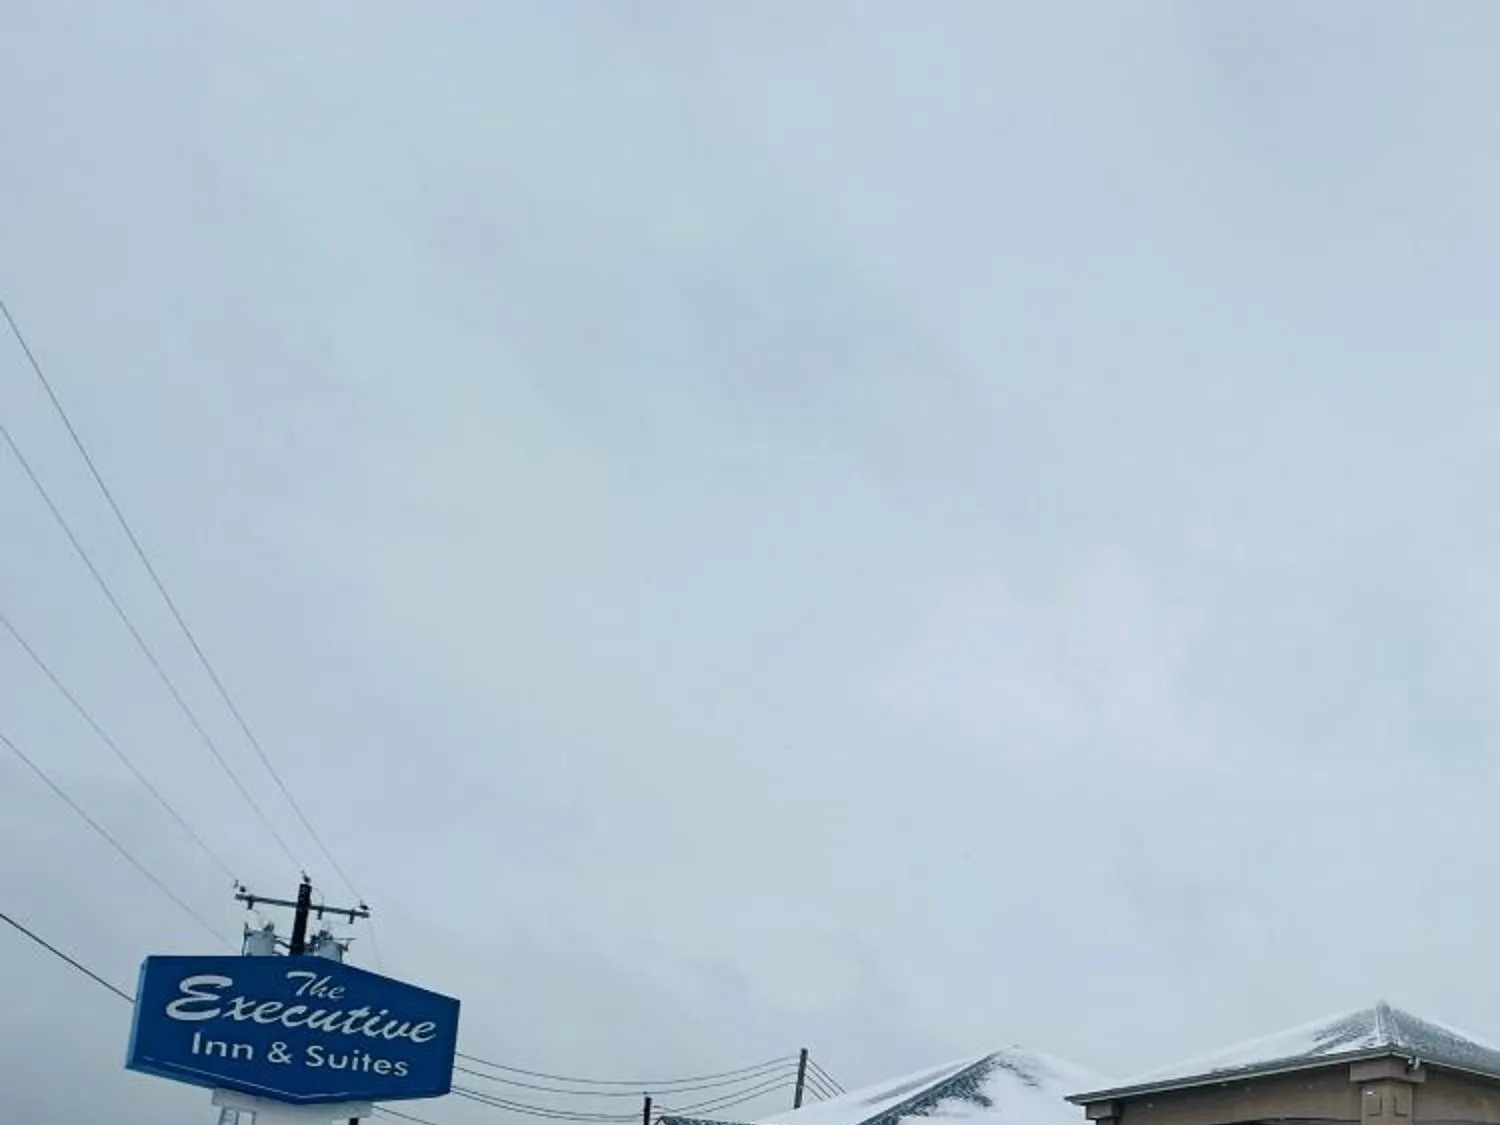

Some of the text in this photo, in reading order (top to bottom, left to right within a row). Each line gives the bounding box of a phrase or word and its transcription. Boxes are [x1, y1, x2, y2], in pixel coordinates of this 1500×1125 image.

[286, 970, 345, 998] The
[166, 975, 437, 1043] Executive
[192, 1031, 408, 1077] Inn & Suites
